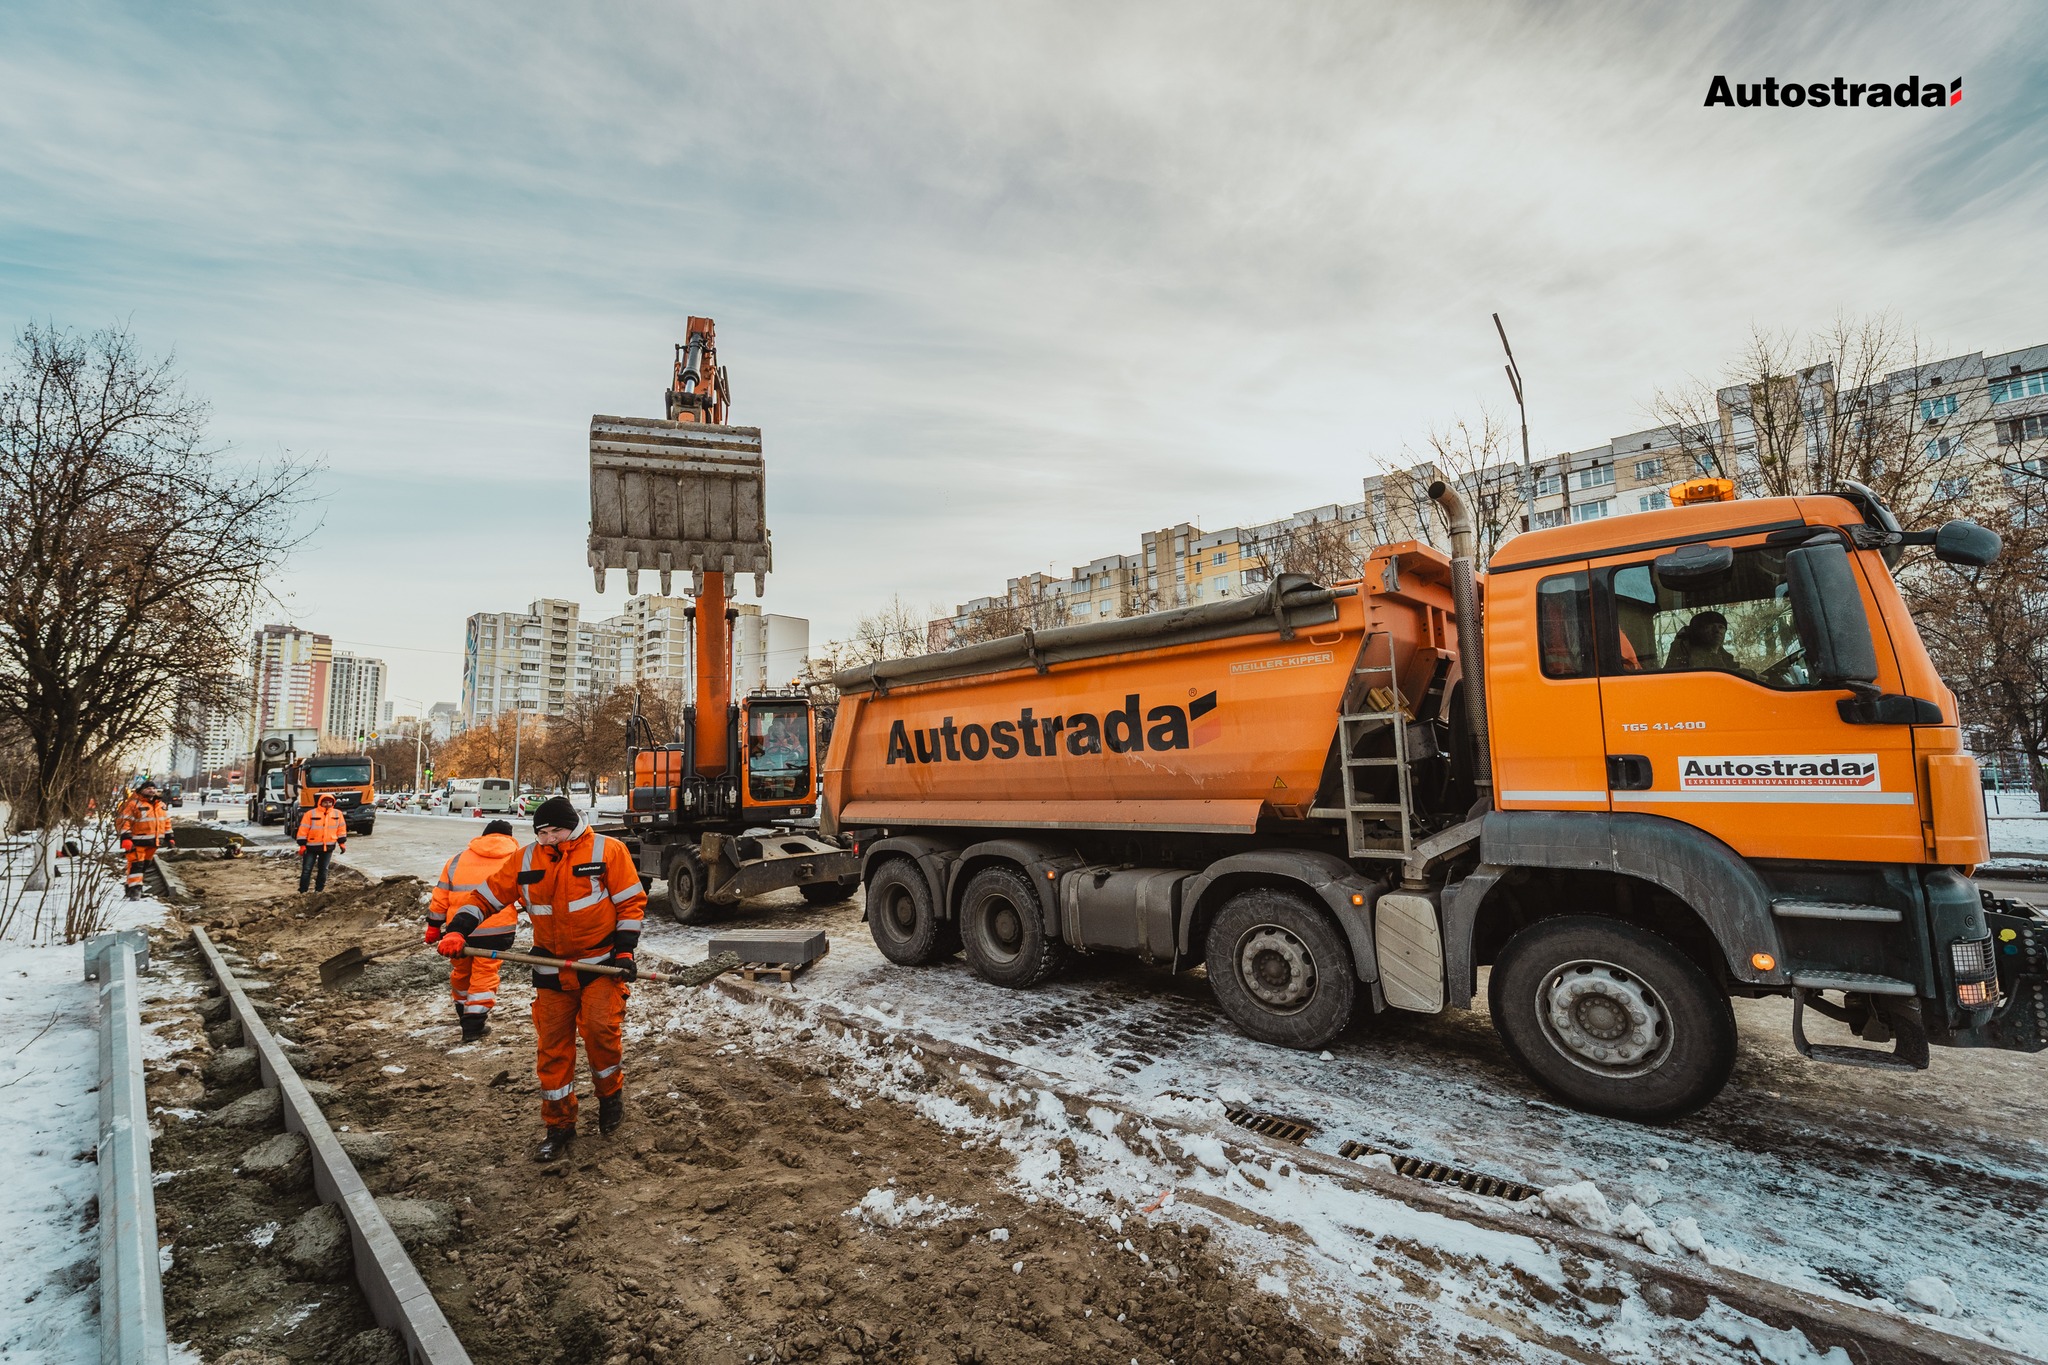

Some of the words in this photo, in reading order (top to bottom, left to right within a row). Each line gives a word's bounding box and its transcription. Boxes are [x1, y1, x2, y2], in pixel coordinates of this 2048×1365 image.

[1231, 653, 1331, 673] MEILLER-KIPPER
[886, 693, 1190, 765] Autostrada
[1621, 723, 1648, 732] TGS
[1652, 721, 1706, 731] 41.400
[1684, 758, 1862, 777] Autostrada
